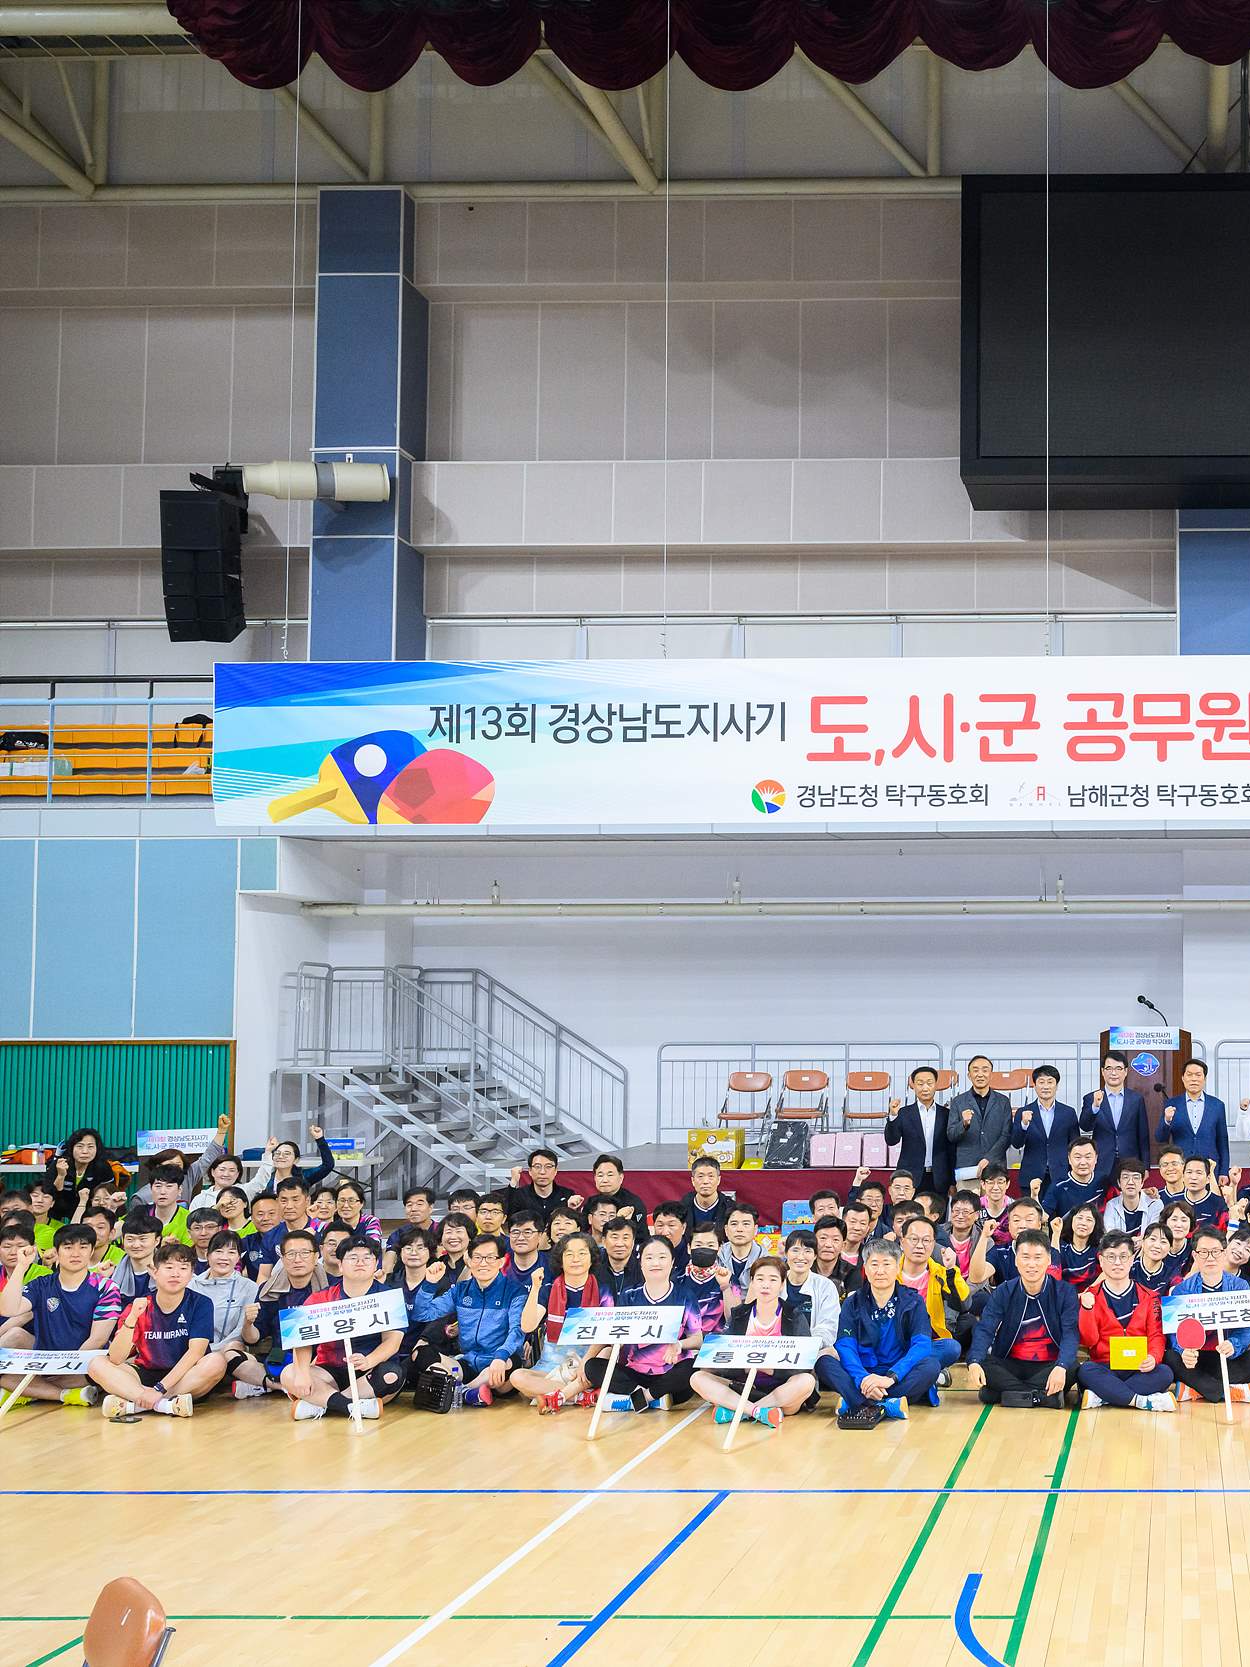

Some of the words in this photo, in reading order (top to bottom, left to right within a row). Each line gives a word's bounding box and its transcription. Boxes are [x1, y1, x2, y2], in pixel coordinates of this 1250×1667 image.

[427, 701, 537, 744] 제13회
[548, 701, 787, 744] 경상남도지사기
[796, 784, 879, 808] 경남도청
[885, 784, 989, 808] 탁구동호회
[1067, 784, 1149, 808] 남해군청
[144, 1331, 162, 1340] TEAM
[163, 1328, 188, 1340] MIRANG
[299, 1311, 390, 1340] 밀양시
[576, 1325, 663, 1340] 진주시
[713, 1351, 800, 1364] 통영시
